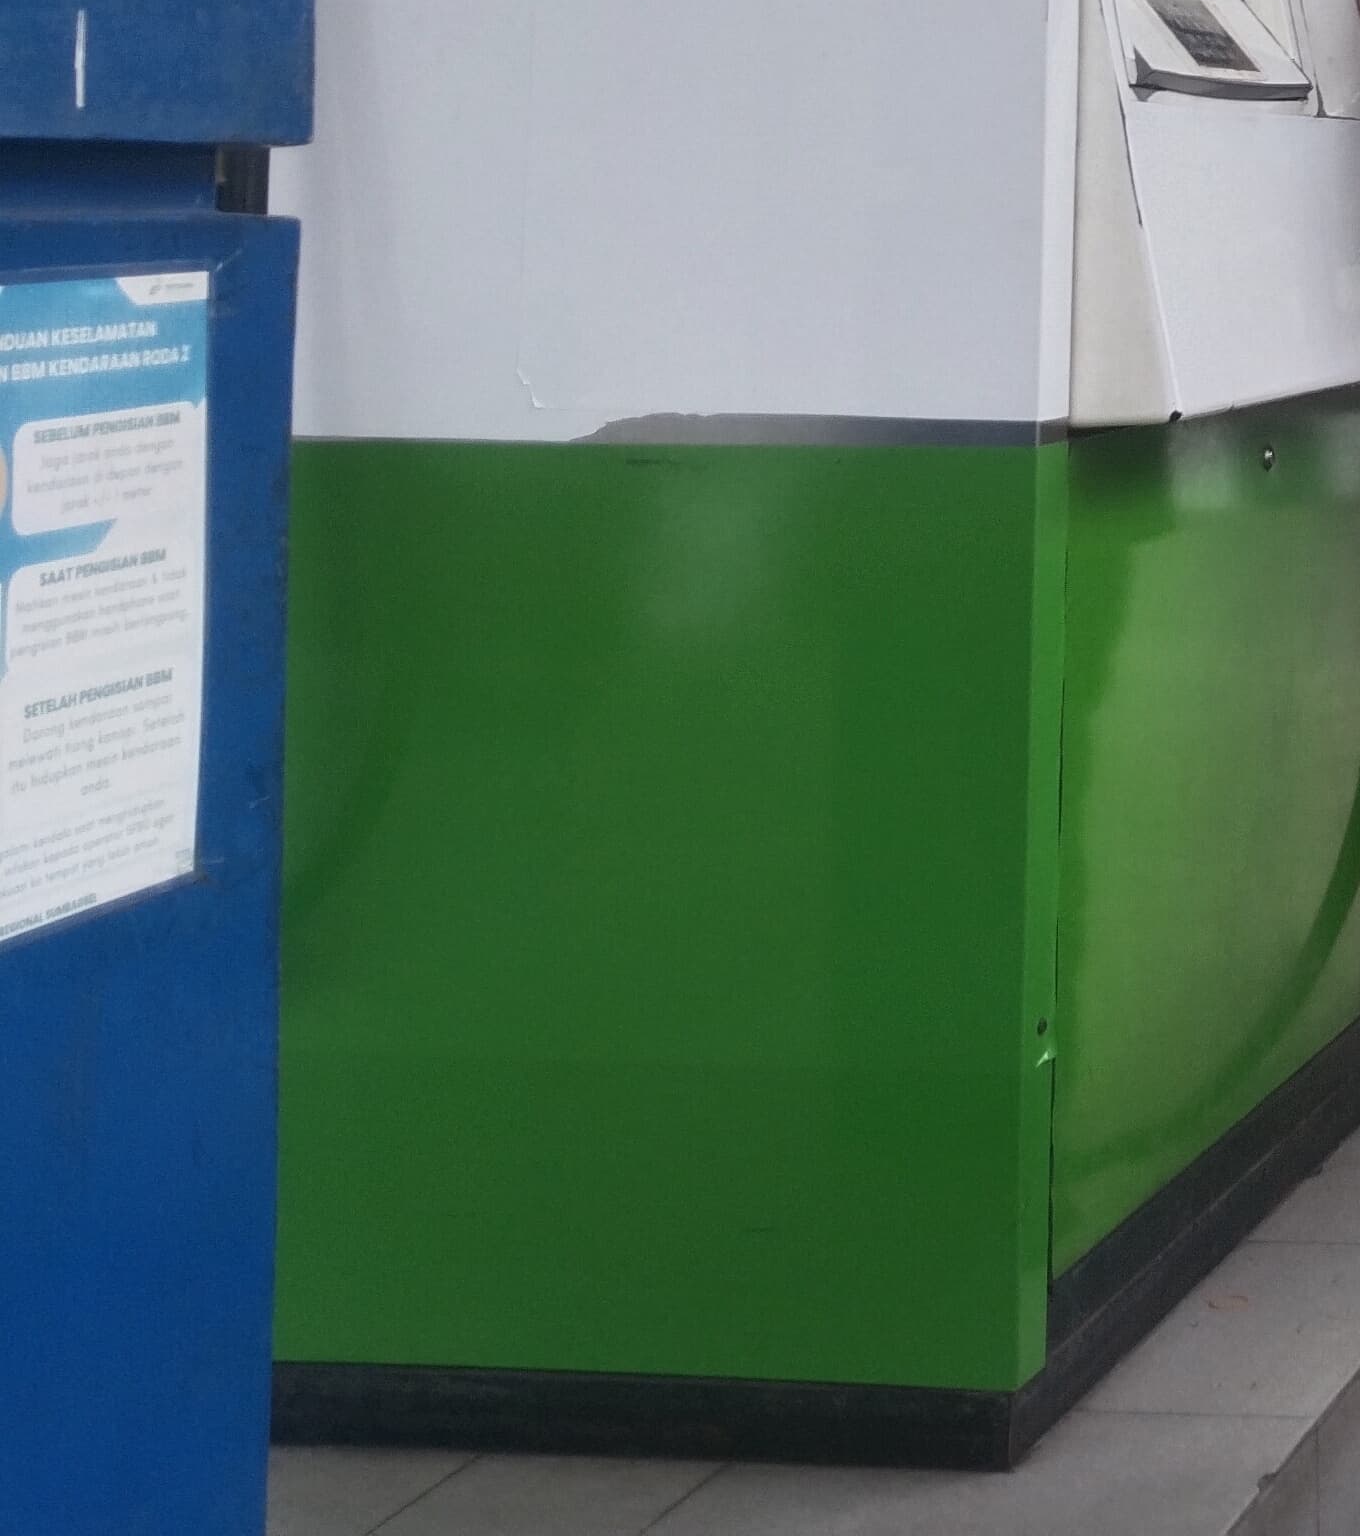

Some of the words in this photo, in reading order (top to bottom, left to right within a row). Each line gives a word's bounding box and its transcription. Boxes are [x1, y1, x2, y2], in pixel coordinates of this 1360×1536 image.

[51, 321, 158, 346] KESELAMATAN
[48, 351, 140, 376] KENDARAAN
[143, 346, 179, 366] RODA
[33, 423, 90, 444] SEBELUM
[92, 416, 154, 437] PENGISIAN
[40, 571, 73, 587] SAAT
[75, 556, 138, 579] PENGISIAN
[141, 548, 166, 563] BBM
[24, 693, 77, 719] SETELAH
[80, 675, 143, 704] PENGISIAN
[146, 667, 173, 687] BBM
